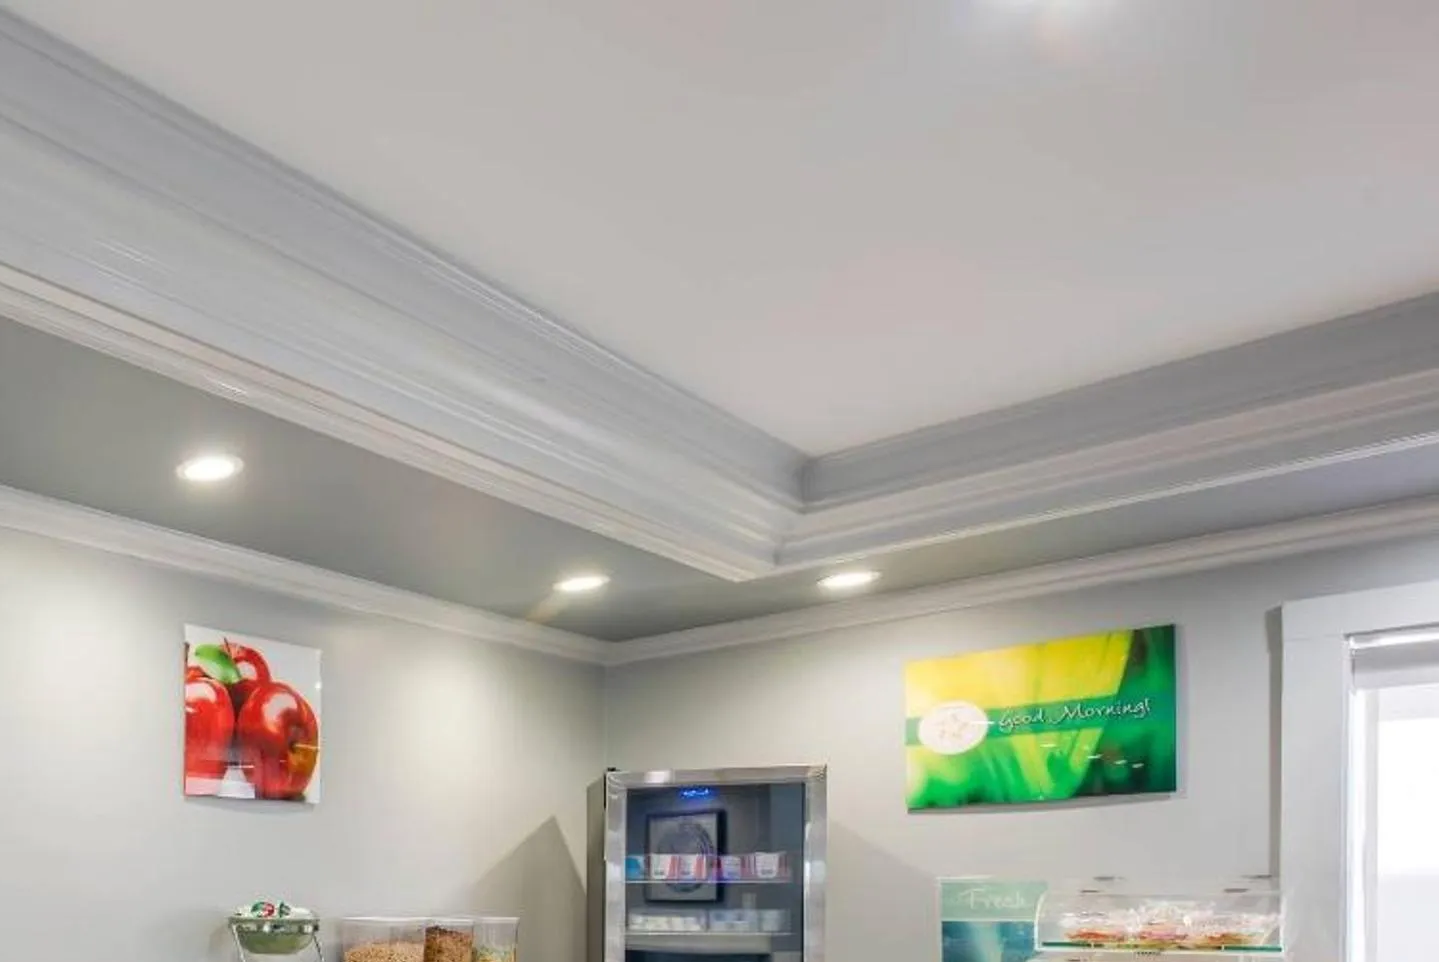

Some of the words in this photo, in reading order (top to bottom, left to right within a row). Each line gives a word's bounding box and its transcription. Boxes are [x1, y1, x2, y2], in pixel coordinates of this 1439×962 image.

[999, 708, 1044, 733] Good
[1048, 698, 1152, 725] Morning!
[958, 887, 1028, 911] Fresh
